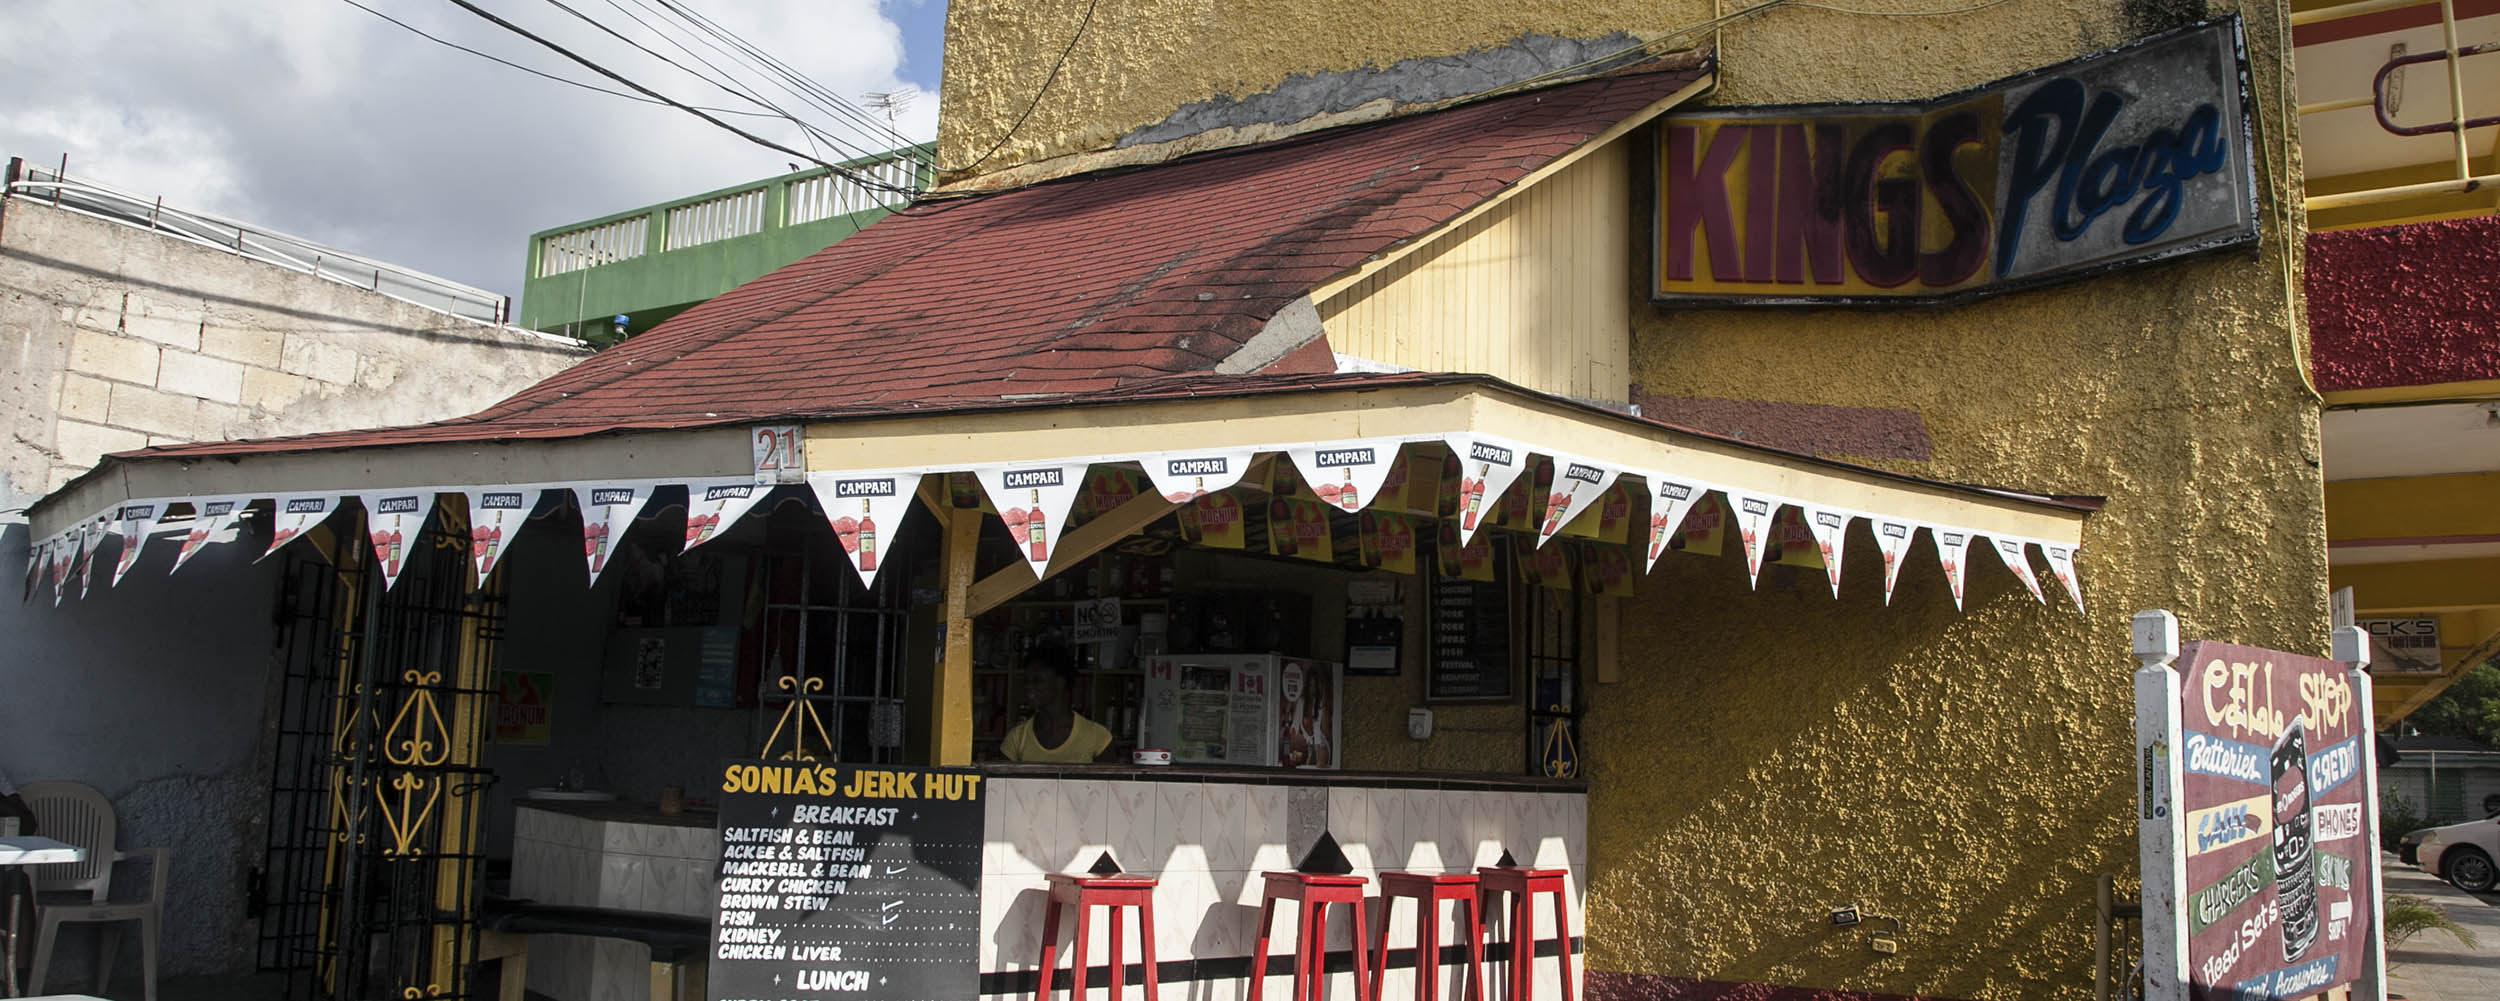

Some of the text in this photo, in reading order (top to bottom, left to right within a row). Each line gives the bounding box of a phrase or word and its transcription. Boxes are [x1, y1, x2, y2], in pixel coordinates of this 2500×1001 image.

[1667, 77, 2226, 287] KINGS Plaza
[758, 428, 800, 471] 21
[1319, 450, 1372, 465] CAMPARI
[1471, 443, 1511, 463] CAMPARI
[1171, 461, 1225, 474] CAMPARI
[1568, 465, 1602, 483] CAMPARI
[1007, 471, 1060, 486] CAMPARI
[594, 491, 631, 503] CAMPARI
[707, 486, 751, 499] CAMPARI
[838, 481, 892, 495] CAMPARI
[1662, 483, 1690, 498] CAMPARI
[289, 500, 324, 512] CAMPARI
[379, 499, 417, 512] CAMPARI
[483, 495, 520, 507] CAMPARI
[1783, 525, 1814, 543] MAGN
[1078, 606, 1098, 624] NO
[1076, 627, 1121, 640] SMOKING
[2355, 621, 2434, 635] ICK'S
[2203, 659, 2352, 741] CELL SHOP
[2187, 735, 2261, 780] Batteries
[2312, 741, 2358, 793] CREDIT
[722, 763, 981, 801] SONIA'S JERK HUT
[793, 805, 899, 826] BREAKFAST
[2318, 806, 2359, 836] PHONES
[724, 828, 854, 846] SALTFISH & BEAN
[724, 845, 865, 862] ACKEE & SALTFISH
[722, 861, 872, 879] MACKEREL & BEAN
[721, 878, 846, 895] CURRY CHICKEN
[2199, 859, 2260, 925] CHARGERS
[720, 894, 829, 911] BROWN STEW
[719, 911, 756, 926] FISH
[718, 928, 781, 944] KIDNEY
[718, 944, 842, 962] CHICKEN LIVER
[2203, 899, 2278, 992] Head Sets
[796, 969, 870, 991] LUNCH
